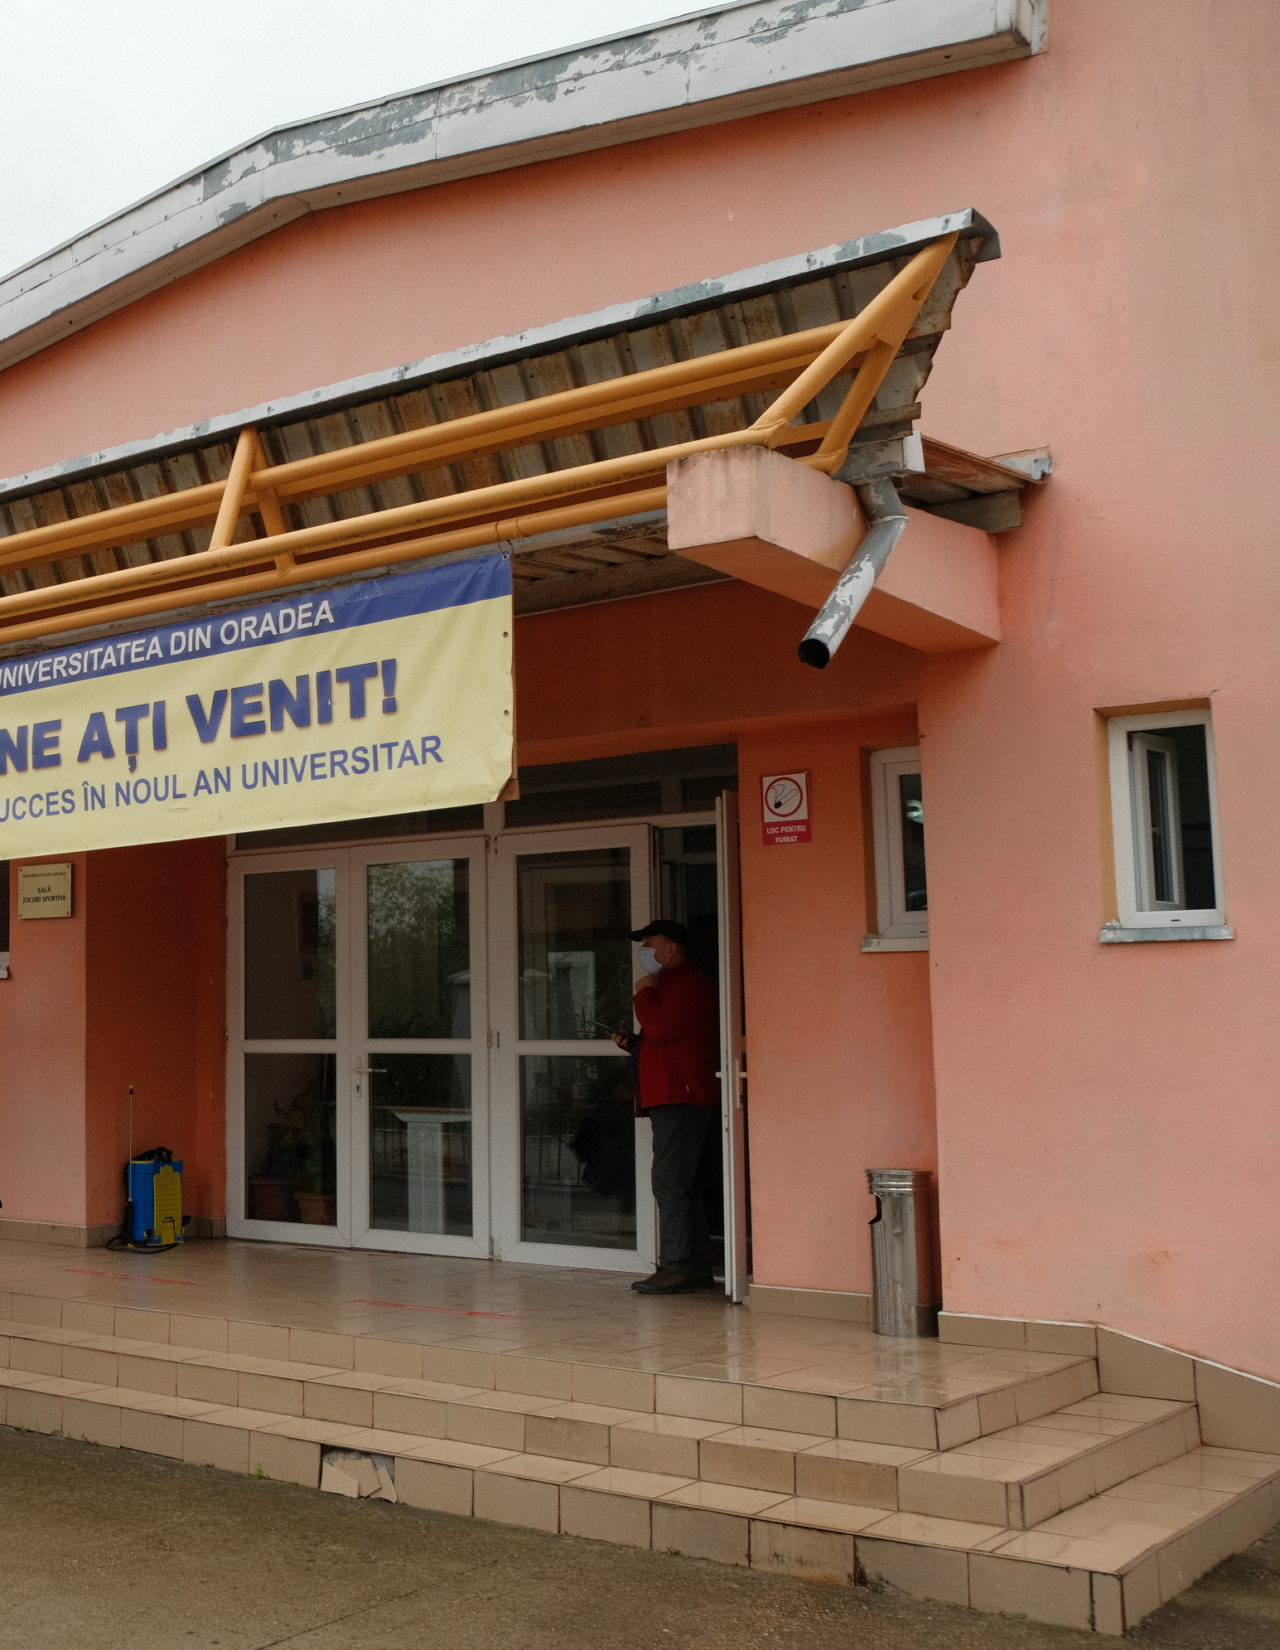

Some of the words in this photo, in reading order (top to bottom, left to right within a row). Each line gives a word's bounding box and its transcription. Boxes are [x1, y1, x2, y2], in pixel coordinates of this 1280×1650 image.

[170, 625, 212, 656] DIN
[219, 600, 335, 645] ORADEA
[76, 700, 168, 773] AȚI
[185, 658, 398, 744] VENIT!
[82, 780, 106, 812] ÎN
[114, 774, 188, 806] NOUL
[193, 766, 231, 797] AN
[241, 734, 444, 791] UNIVERSITAR
